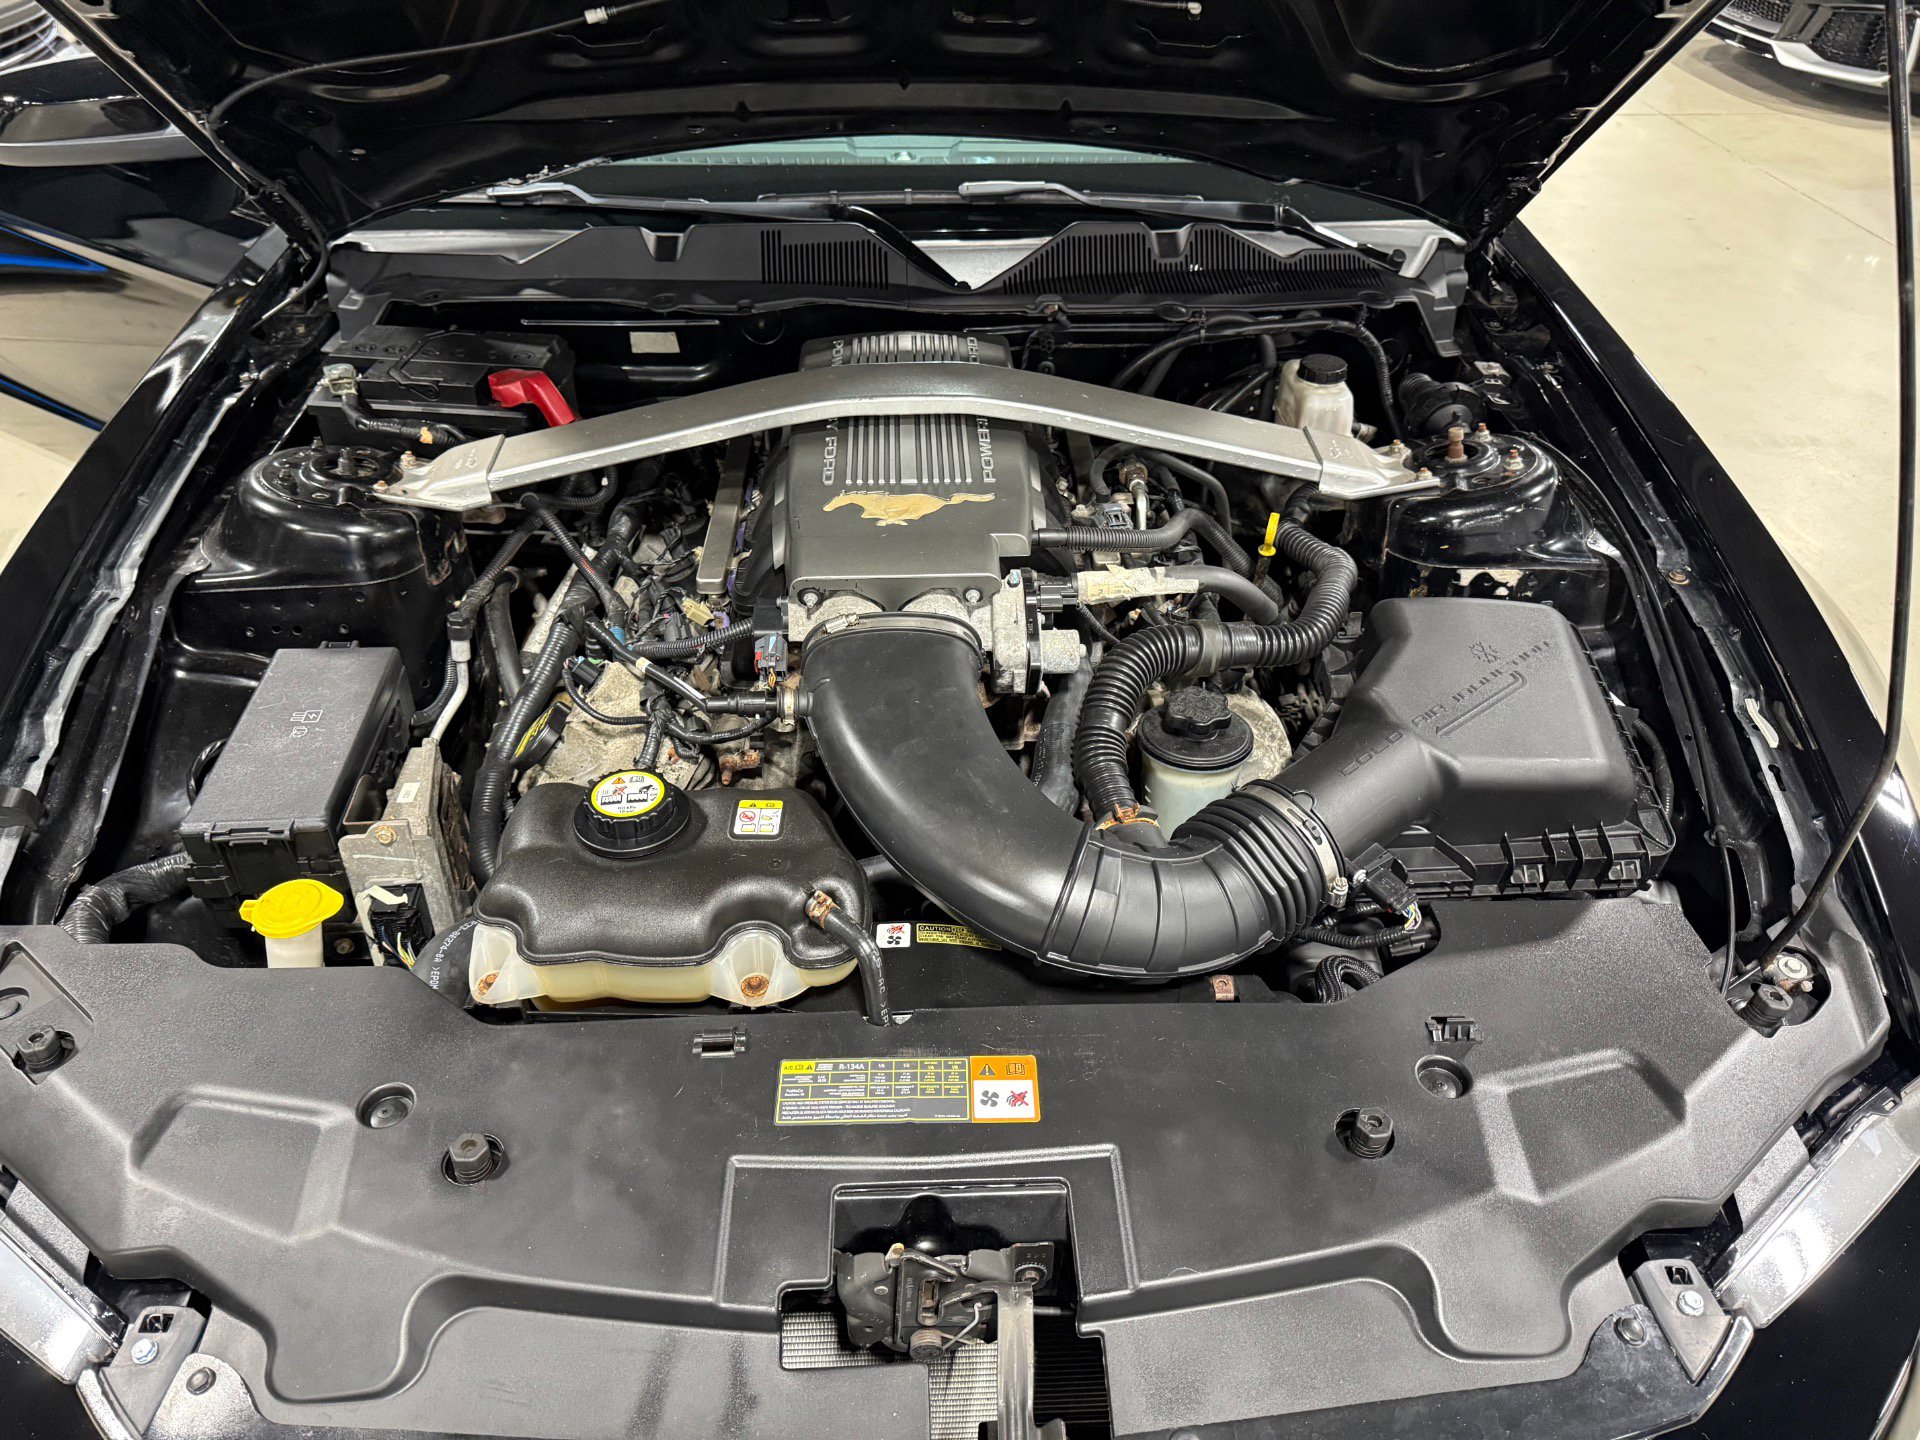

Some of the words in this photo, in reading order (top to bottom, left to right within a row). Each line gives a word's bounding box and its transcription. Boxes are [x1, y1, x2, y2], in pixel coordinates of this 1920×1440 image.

[967, 337, 980, 364] ORD
[822, 436, 837, 485] FORD
[976, 418, 997, 483] POWER
[1341, 730, 1403, 777] COLD
[1411, 704, 1448, 728] AIR
